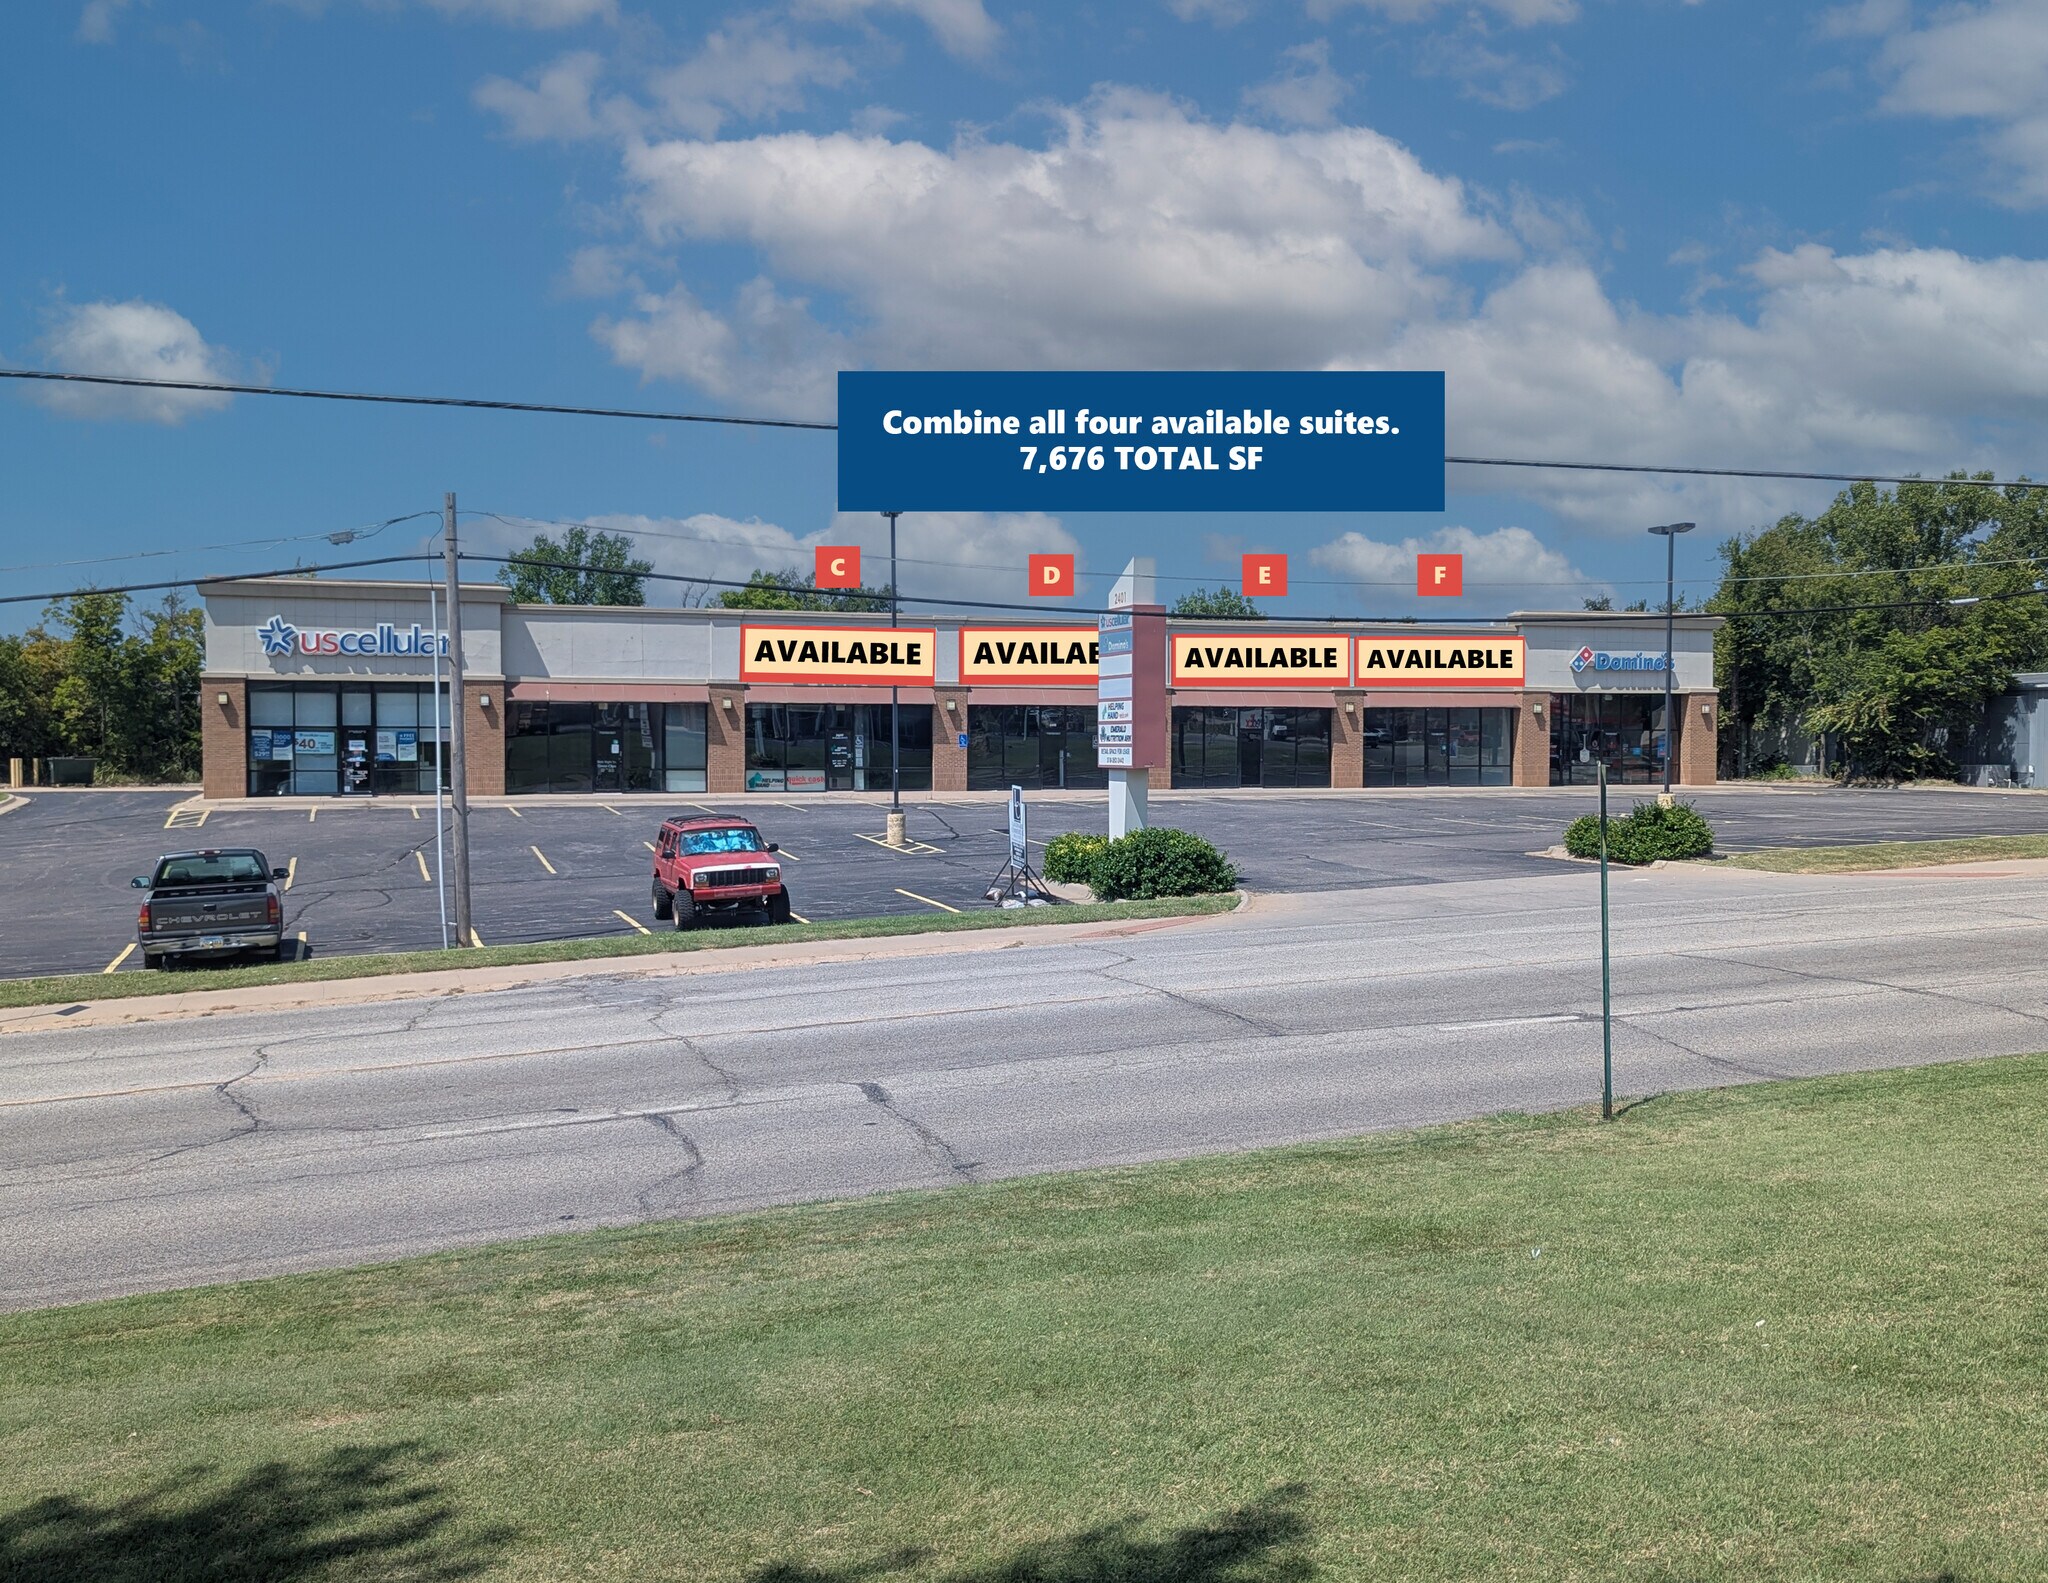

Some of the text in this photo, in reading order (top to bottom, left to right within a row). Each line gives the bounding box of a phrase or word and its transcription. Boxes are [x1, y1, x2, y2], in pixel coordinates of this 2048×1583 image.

[1114, 591, 1127, 605] 2401
[301, 625, 449, 655] uscellular
[1595, 652, 1675, 671] Domino's
[157, 911, 262, 925] CHEVROLET
